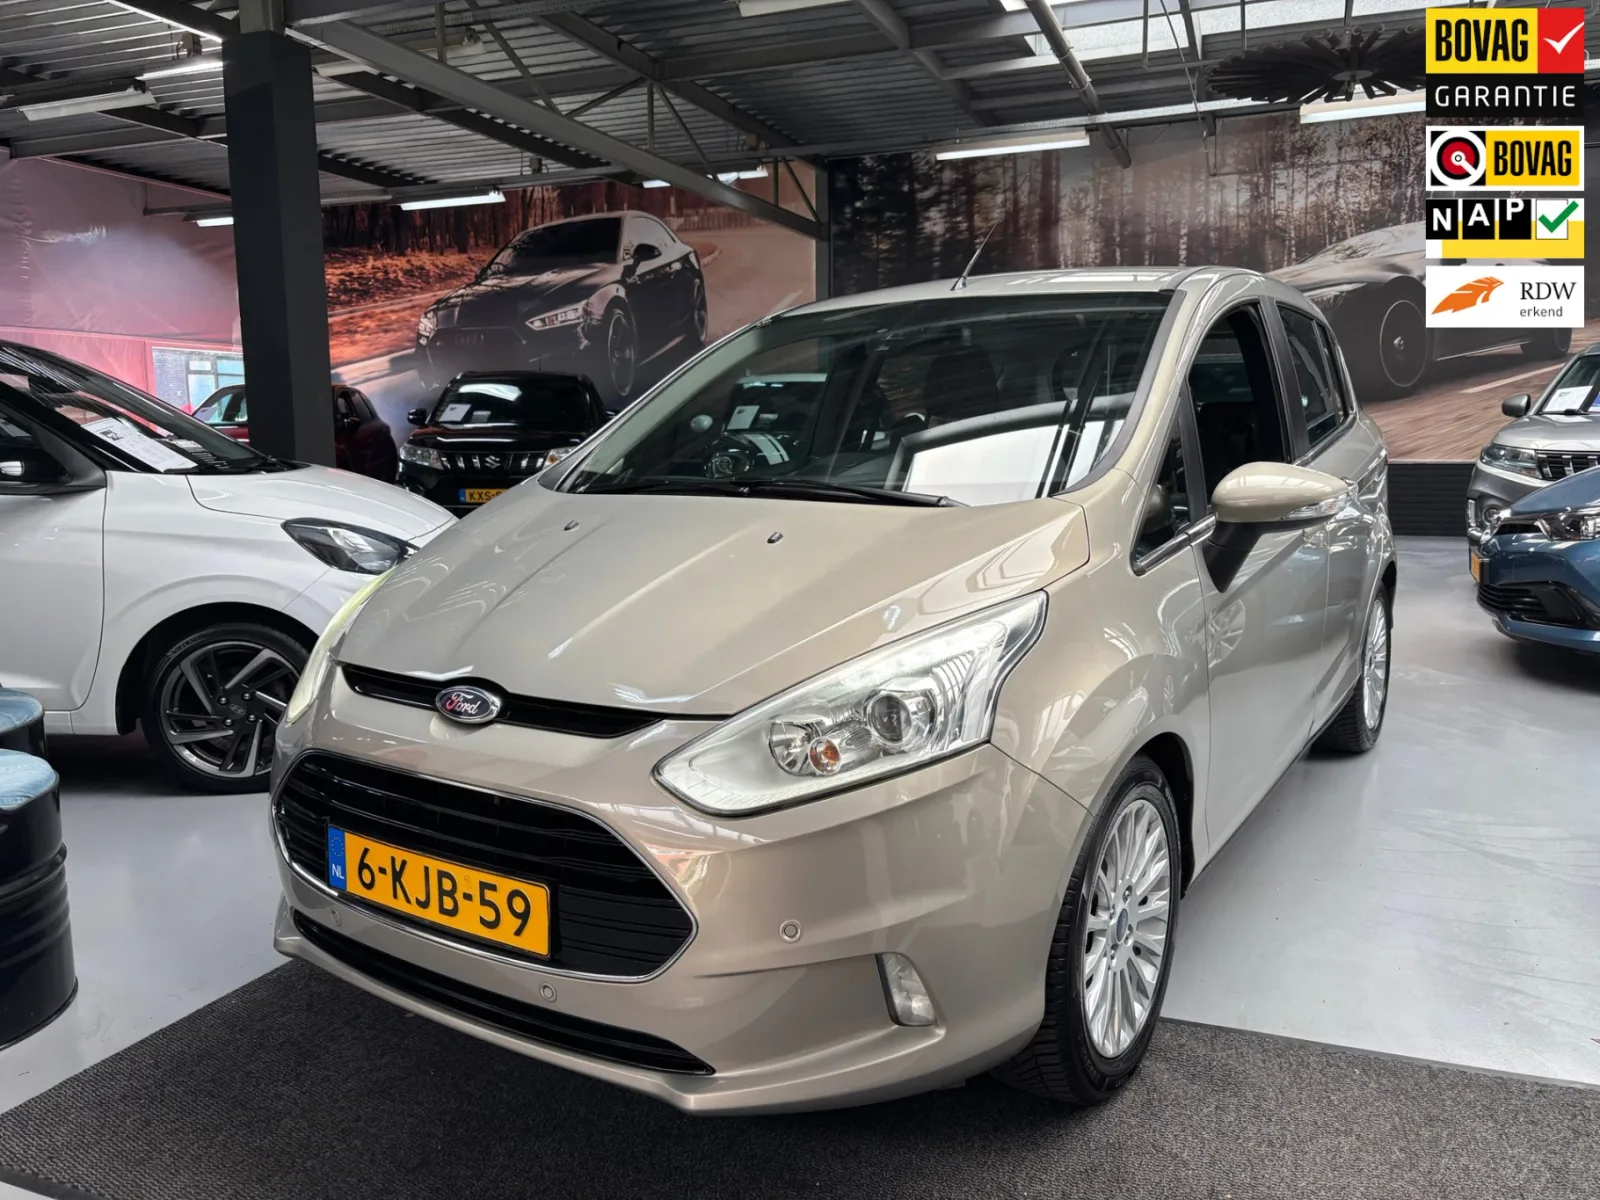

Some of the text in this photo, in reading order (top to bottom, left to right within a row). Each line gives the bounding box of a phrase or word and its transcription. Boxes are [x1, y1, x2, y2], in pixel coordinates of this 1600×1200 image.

[446, 691, 482, 715] Ford
[331, 864, 345, 880] NL
[358, 847, 532, 937] 6-KJB-59
